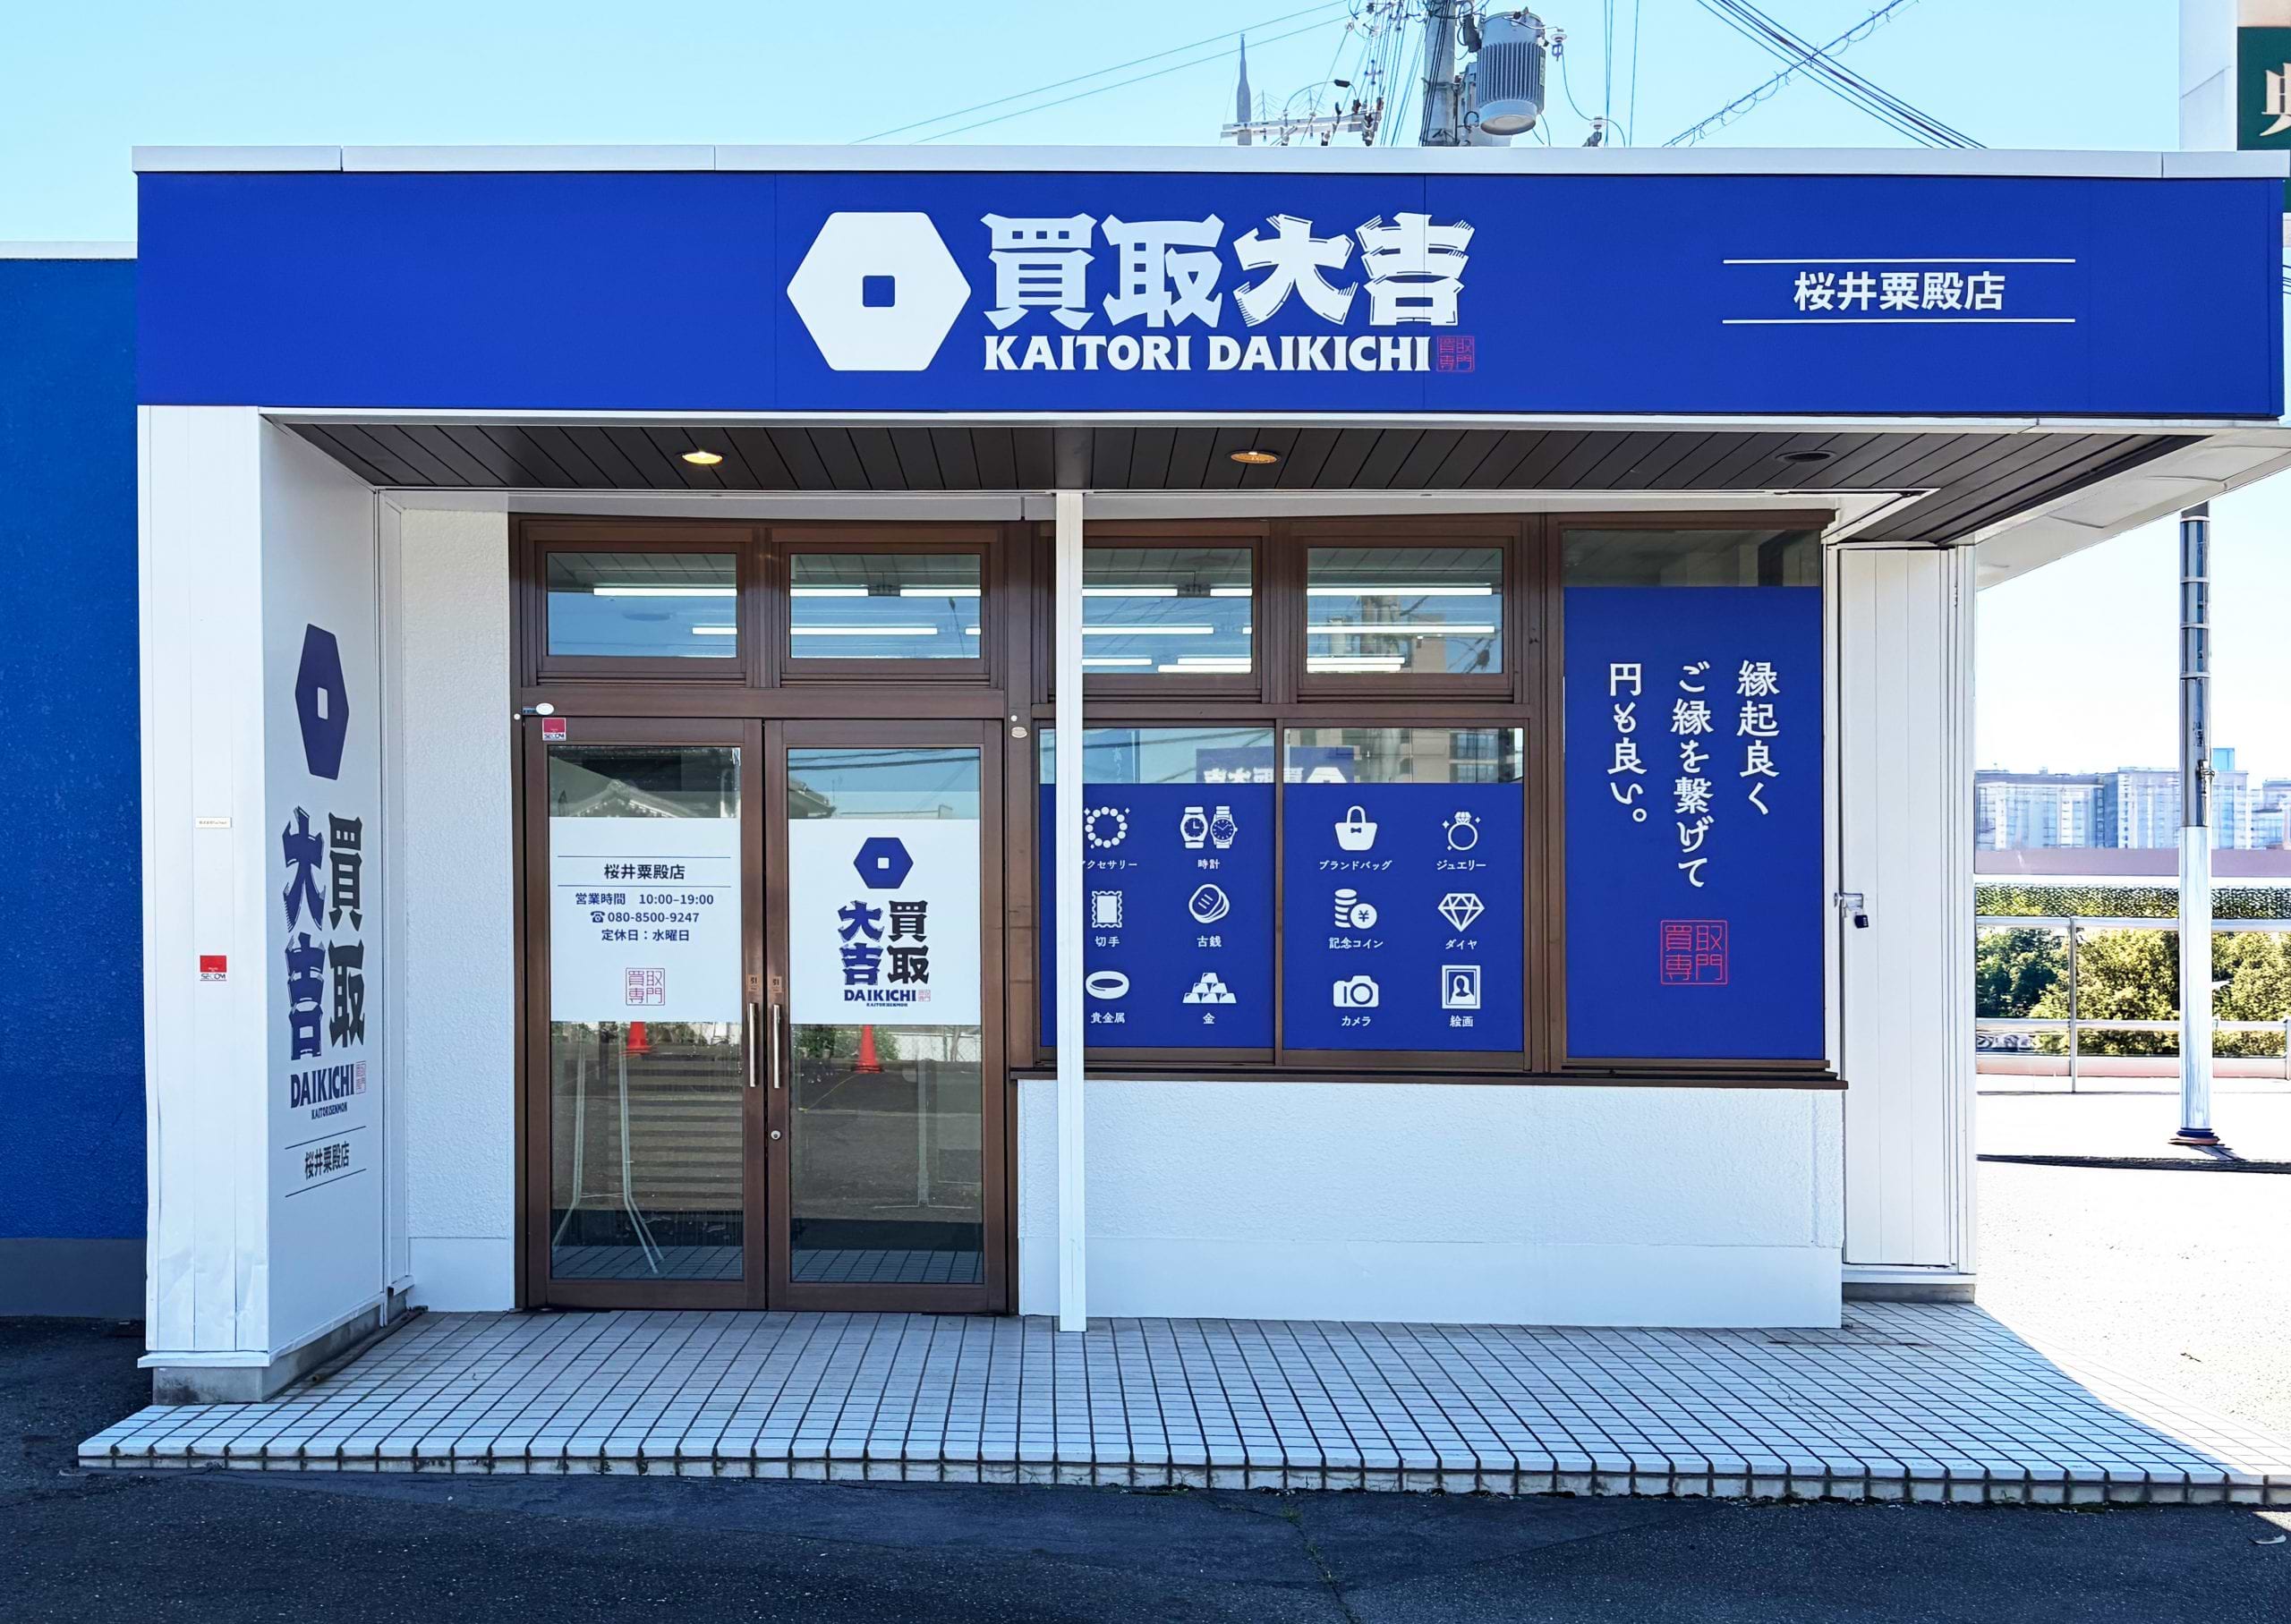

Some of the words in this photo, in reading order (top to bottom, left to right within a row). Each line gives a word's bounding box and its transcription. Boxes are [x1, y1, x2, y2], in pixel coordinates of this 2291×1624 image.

[981, 212, 1476, 330] 買取大吉
[1793, 271, 2006, 310] 桜井粟殿店
[984, 336, 1190, 371] KAITORI
[1207, 336, 1431, 371] DAIKICHI
[1607, 663, 1648, 822] 円も良い。
[1736, 660, 1780, 815] 縁起良く
[1671, 661, 1715, 888] ご縁を繋げて
[1197, 859, 1221, 870] 時計
[1319, 860, 1392, 871] ブランドバッグ
[1436, 860, 1486, 871] ジュエリー
[603, 863, 686, 880] 桜井粟殿店
[575, 893, 626, 906] 営業時間
[608, 912, 700, 923] 080-8500-9247
[282, 805, 326, 1060] 大吉
[328, 812, 365, 1048] 買取
[838, 900, 884, 985] 大吉
[887, 900, 929, 984] 買取
[1094, 936, 1120, 948] 切手
[1197, 936, 1222, 948] 古銭
[1329, 937, 1384, 949] 記念コイン
[1445, 939, 1478, 950] ダイヤ
[844, 989, 916, 1001] DAIKICHI
[1090, 1012, 1125, 1025] 貴金属
[1202, 1013, 1215, 1025] 金
[1341, 1016, 1371, 1027] カメラ
[1450, 1015, 1474, 1027] 絵画
[291, 1064, 354, 1109] DAIKICHI
[305, 1141, 350, 1180] 桜井粟殿店
